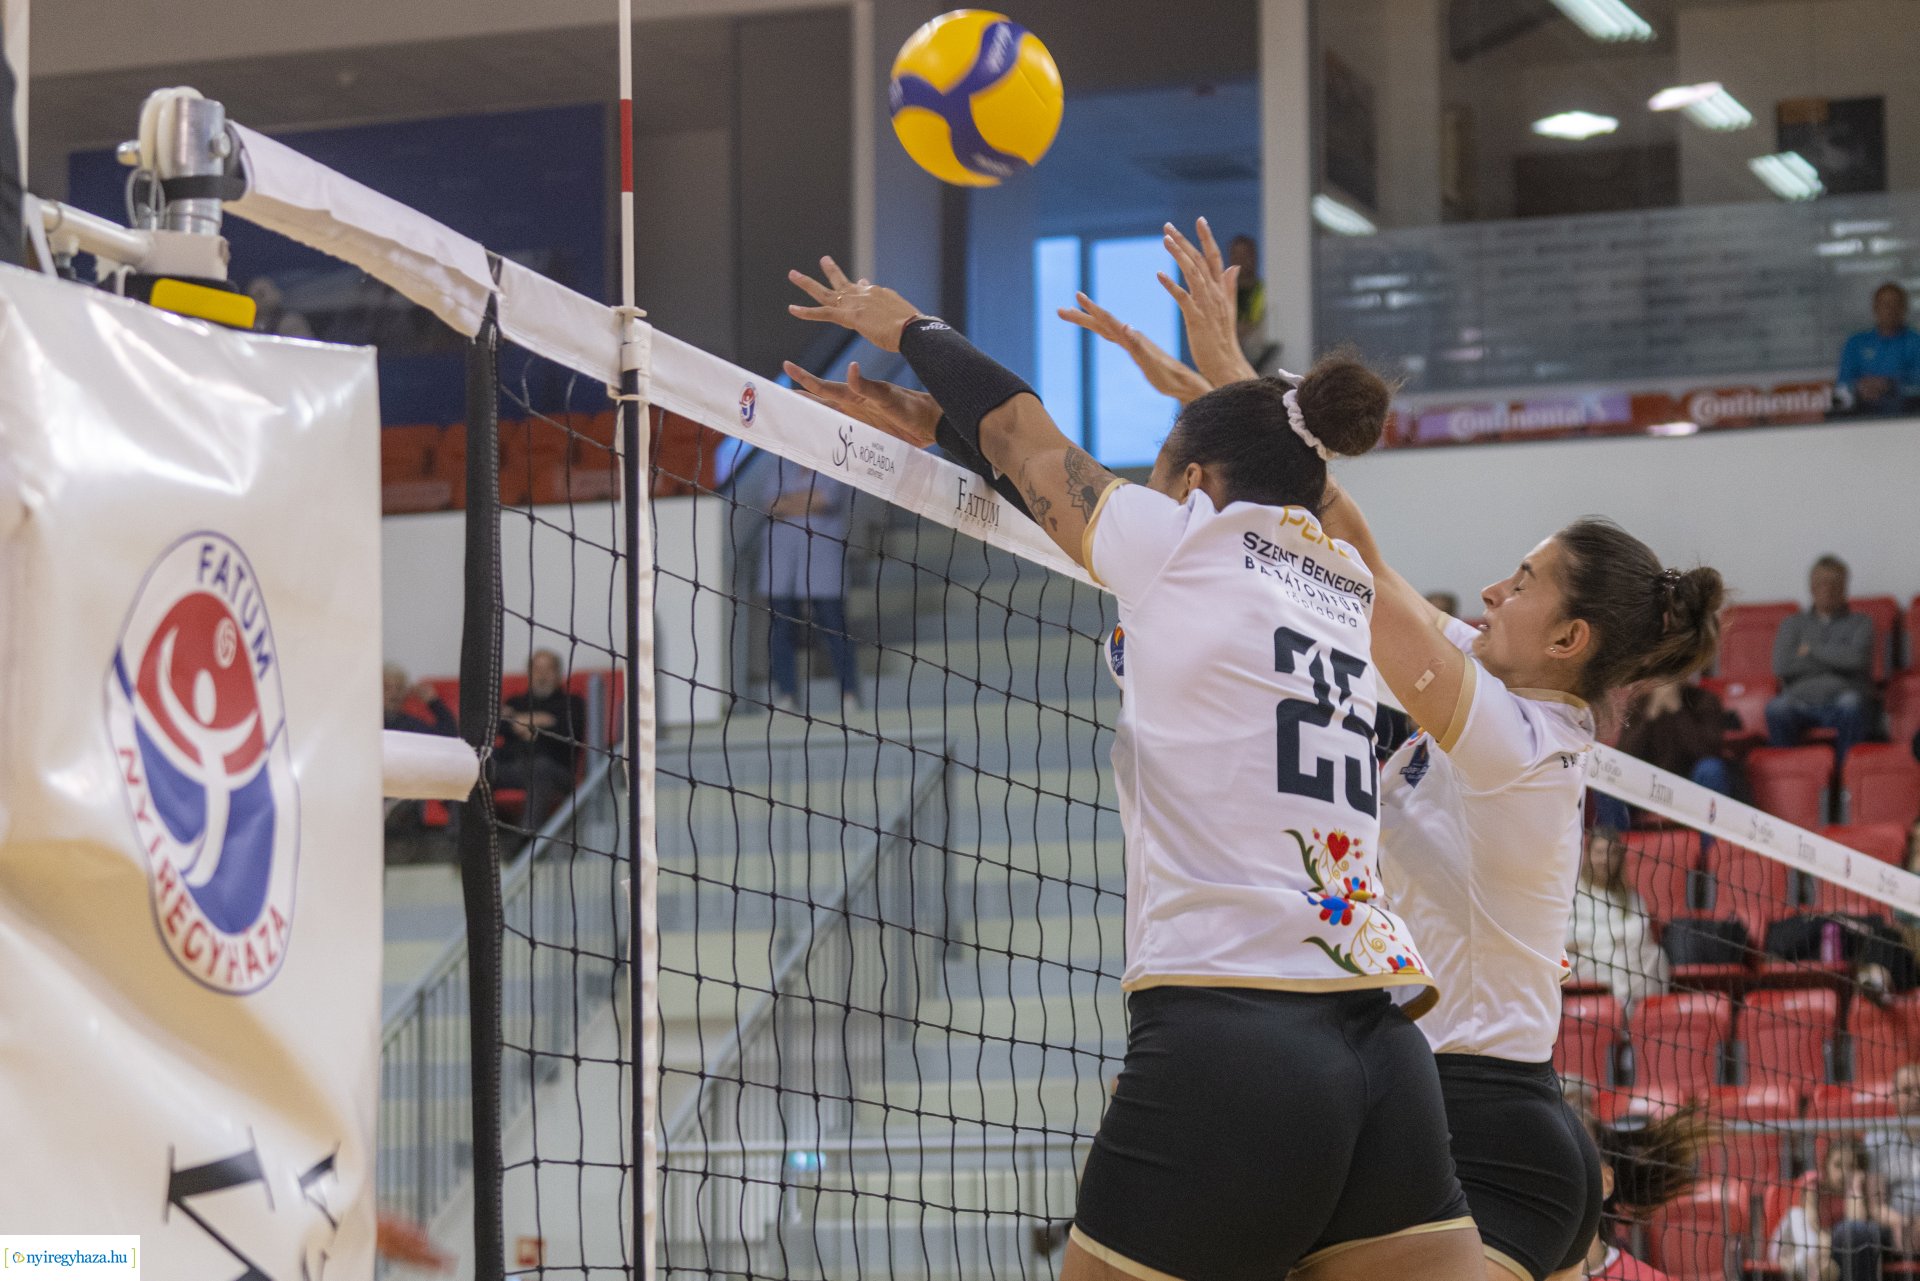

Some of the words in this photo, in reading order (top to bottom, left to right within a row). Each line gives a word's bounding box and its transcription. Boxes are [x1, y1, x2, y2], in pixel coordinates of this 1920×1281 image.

[956, 476, 1000, 526] FATUM
[197, 542, 274, 682] FATUM
[1243, 531, 1299, 568] SZENT
[1301, 554, 1374, 605] BENEDEK
[1273, 625, 1378, 821] 25
